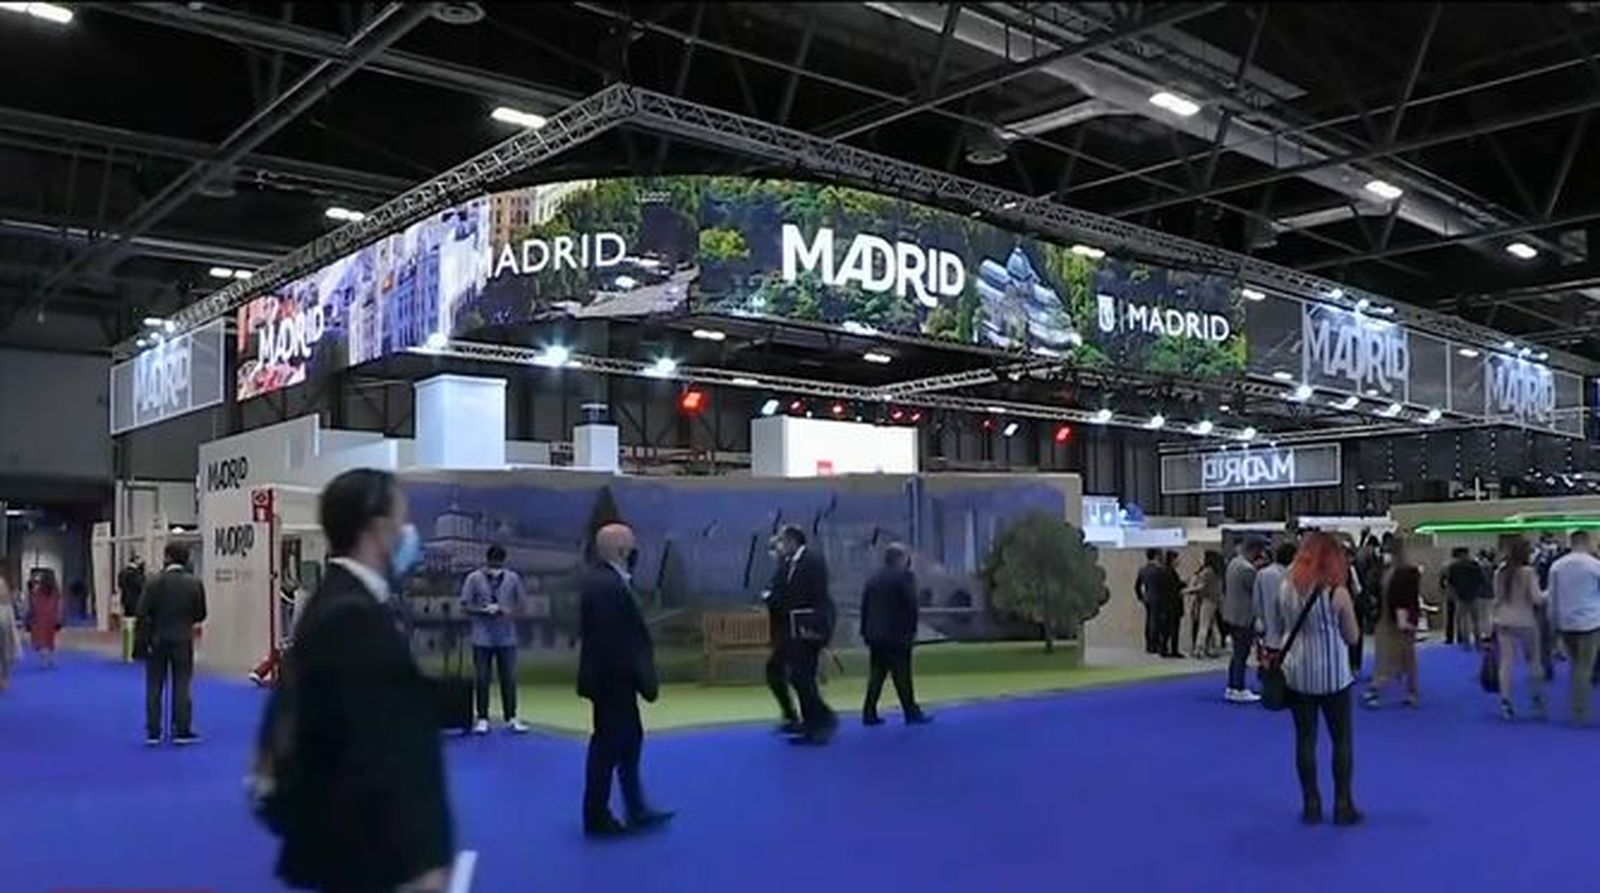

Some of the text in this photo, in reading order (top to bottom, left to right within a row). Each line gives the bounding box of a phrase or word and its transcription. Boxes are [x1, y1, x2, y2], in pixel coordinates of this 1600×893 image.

[781, 223, 965, 308] MADRID
[258, 306, 324, 365] MADRID
[1128, 303, 1230, 341] MADRID
[1303, 314, 1410, 393] MADRID
